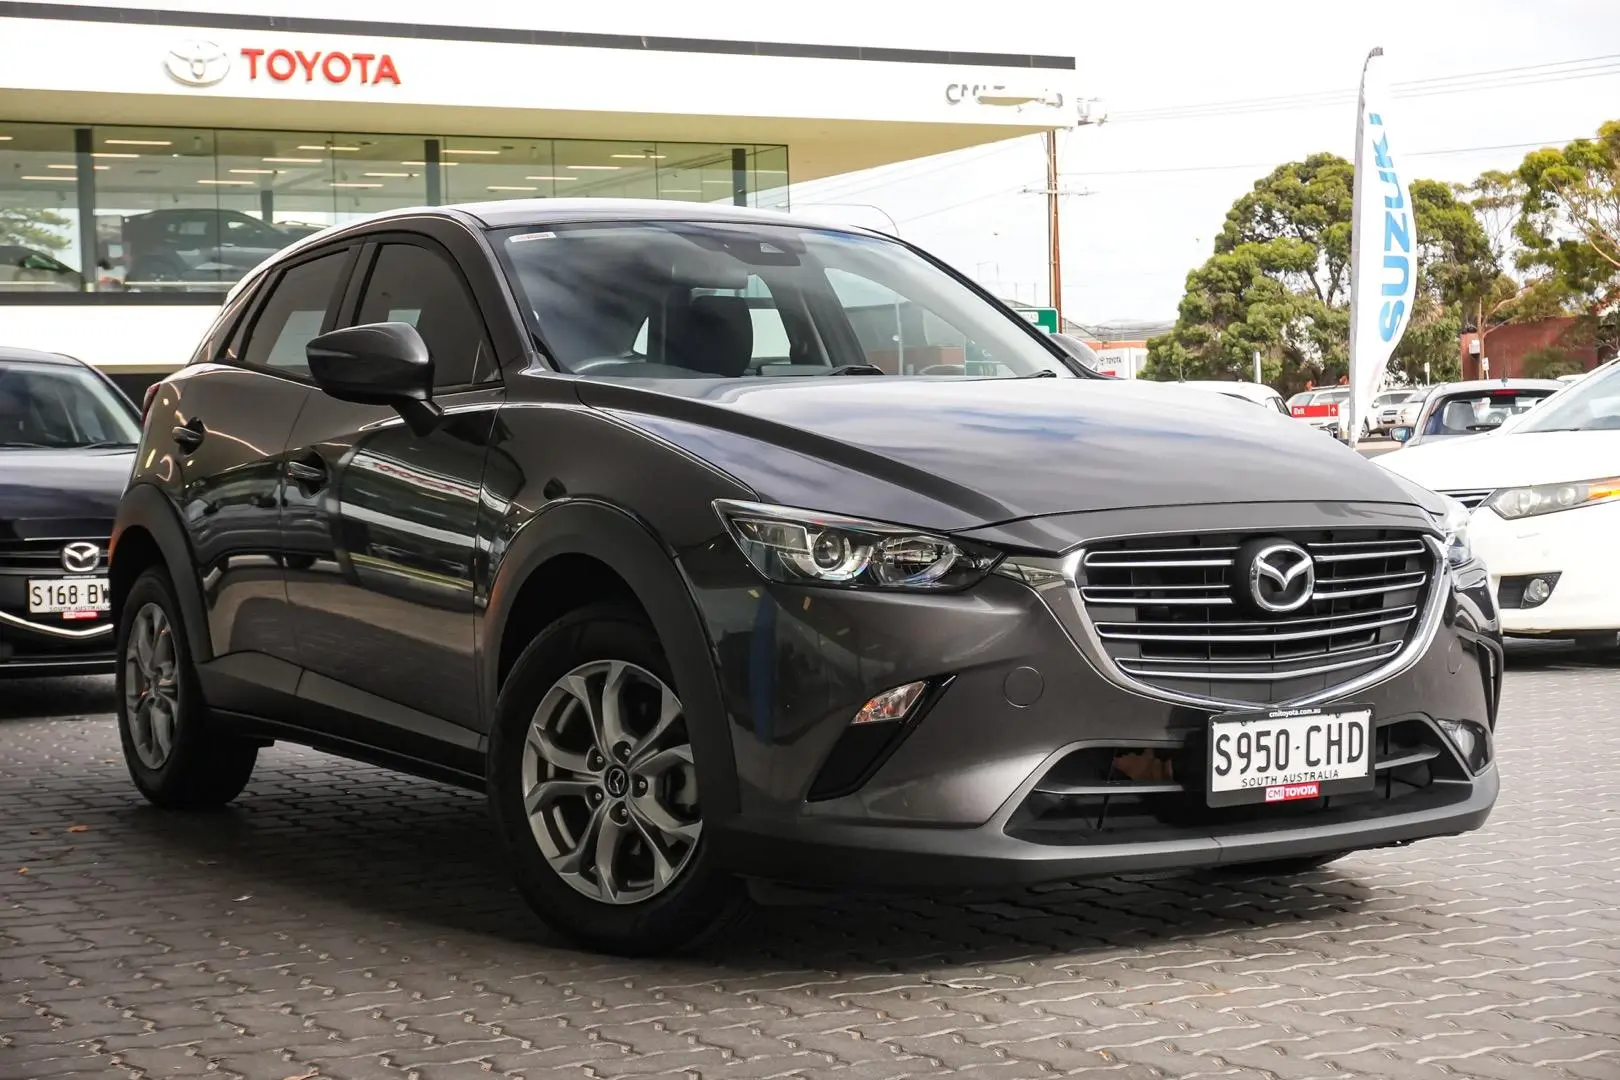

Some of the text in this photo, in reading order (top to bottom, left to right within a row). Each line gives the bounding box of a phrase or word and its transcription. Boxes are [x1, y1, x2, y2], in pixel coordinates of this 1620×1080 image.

[241, 48, 401, 85] TOYOTA
[1369, 112, 1410, 343] SUZUKI
[1269, 708, 1321, 718] cmitoyota.com.au
[1242, 769, 1339, 787] SOUTH AUSTRALIA
[1285, 785, 1318, 797] TOYOTA
